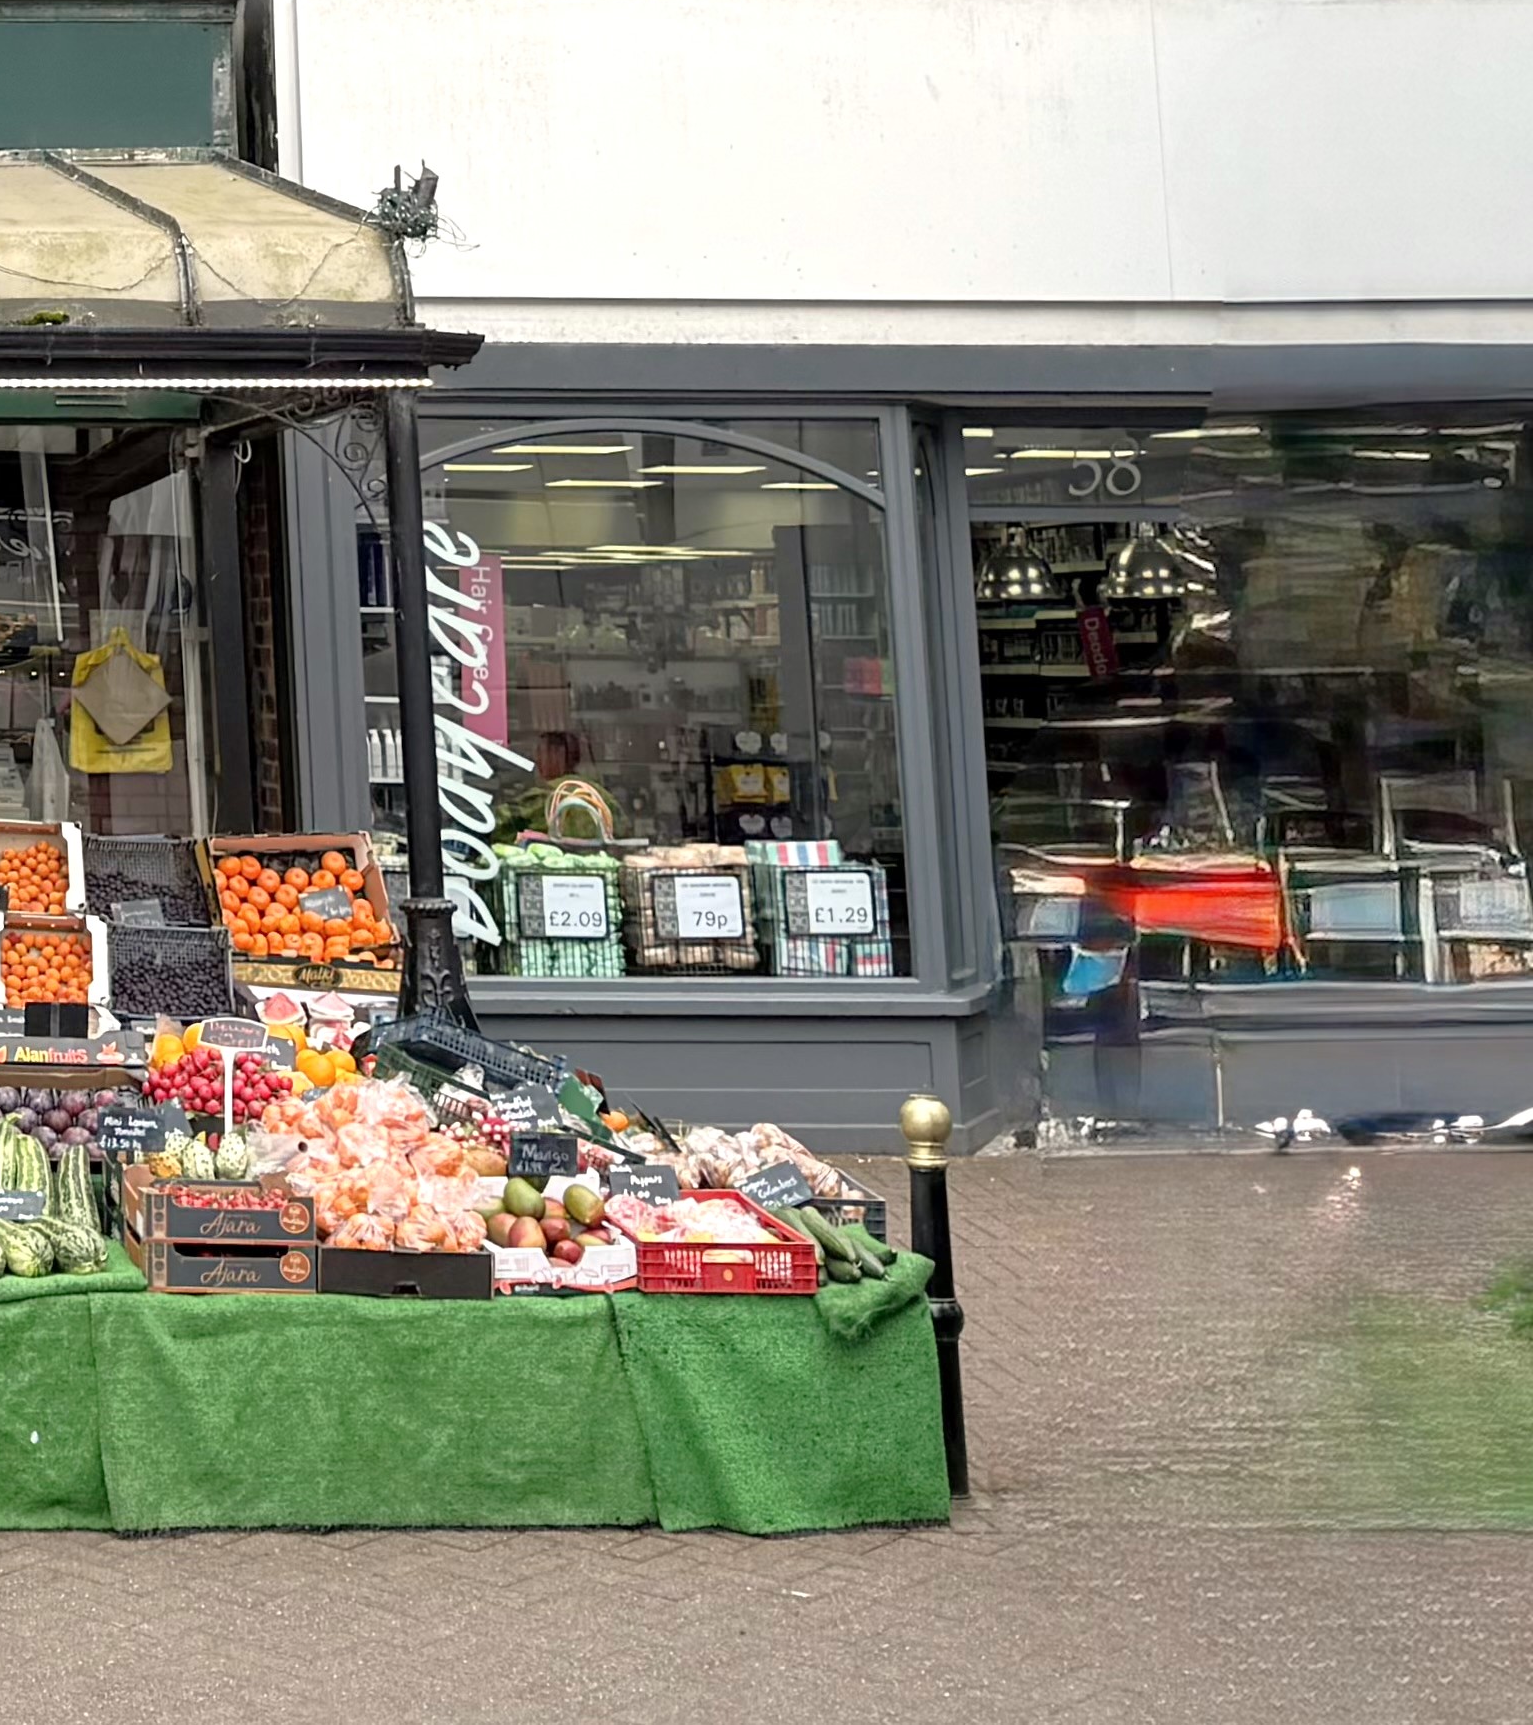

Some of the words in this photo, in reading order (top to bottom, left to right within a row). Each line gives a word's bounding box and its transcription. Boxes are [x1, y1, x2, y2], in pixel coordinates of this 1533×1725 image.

[549, 911, 603, 927] £2.09
[692, 910, 728, 930] 79p
[815, 906, 869, 924] £1.29
[522, 1143, 569, 1165] Mango
